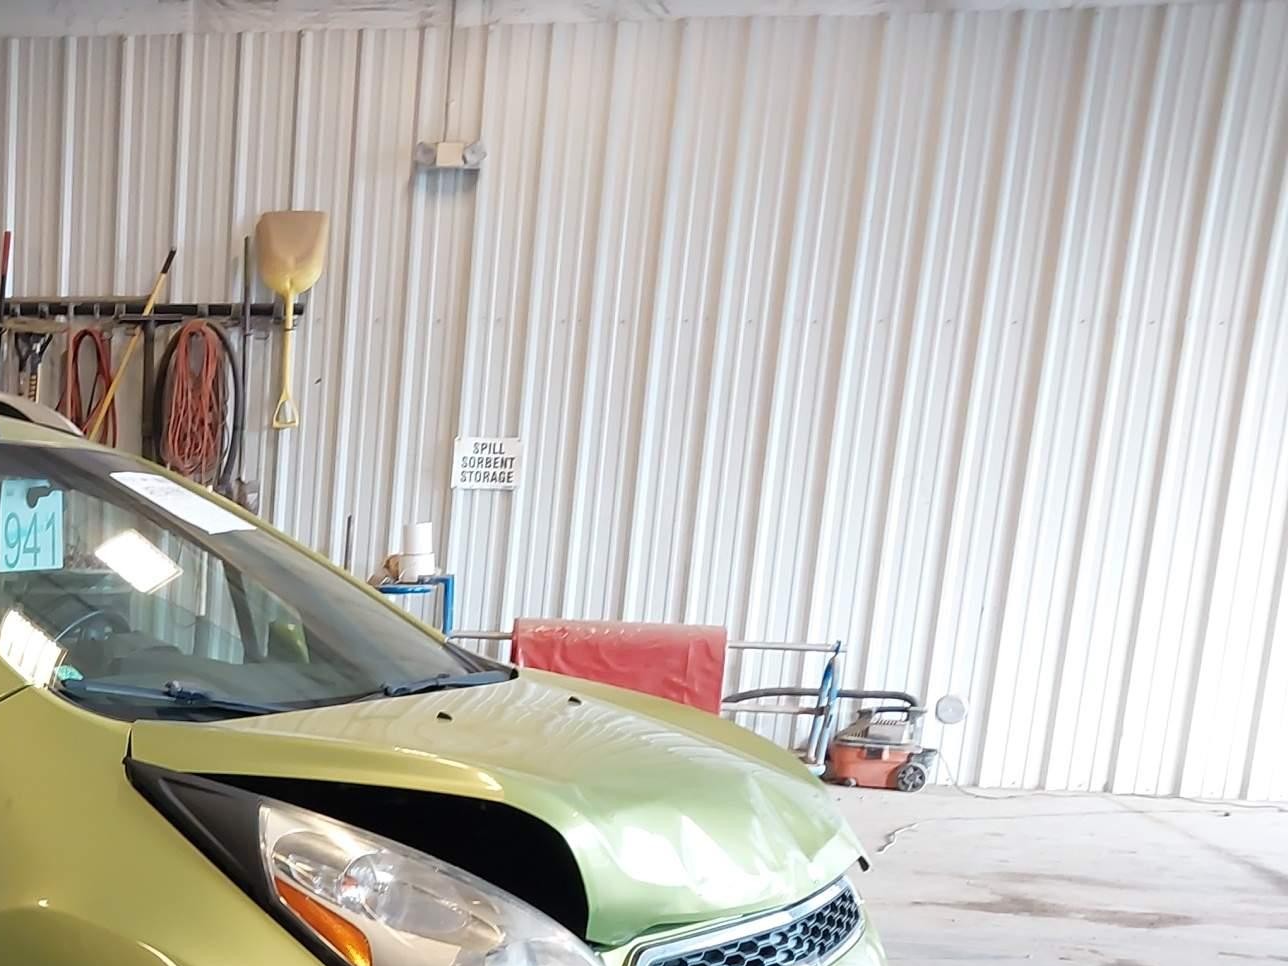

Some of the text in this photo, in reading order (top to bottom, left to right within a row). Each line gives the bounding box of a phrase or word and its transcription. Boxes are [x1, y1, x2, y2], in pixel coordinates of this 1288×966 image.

[472, 442, 505, 455] SPILL
[461, 456, 516, 469] SORBENT
[460, 470, 514, 483] STORAGE
[3, 511, 57, 569] 941
